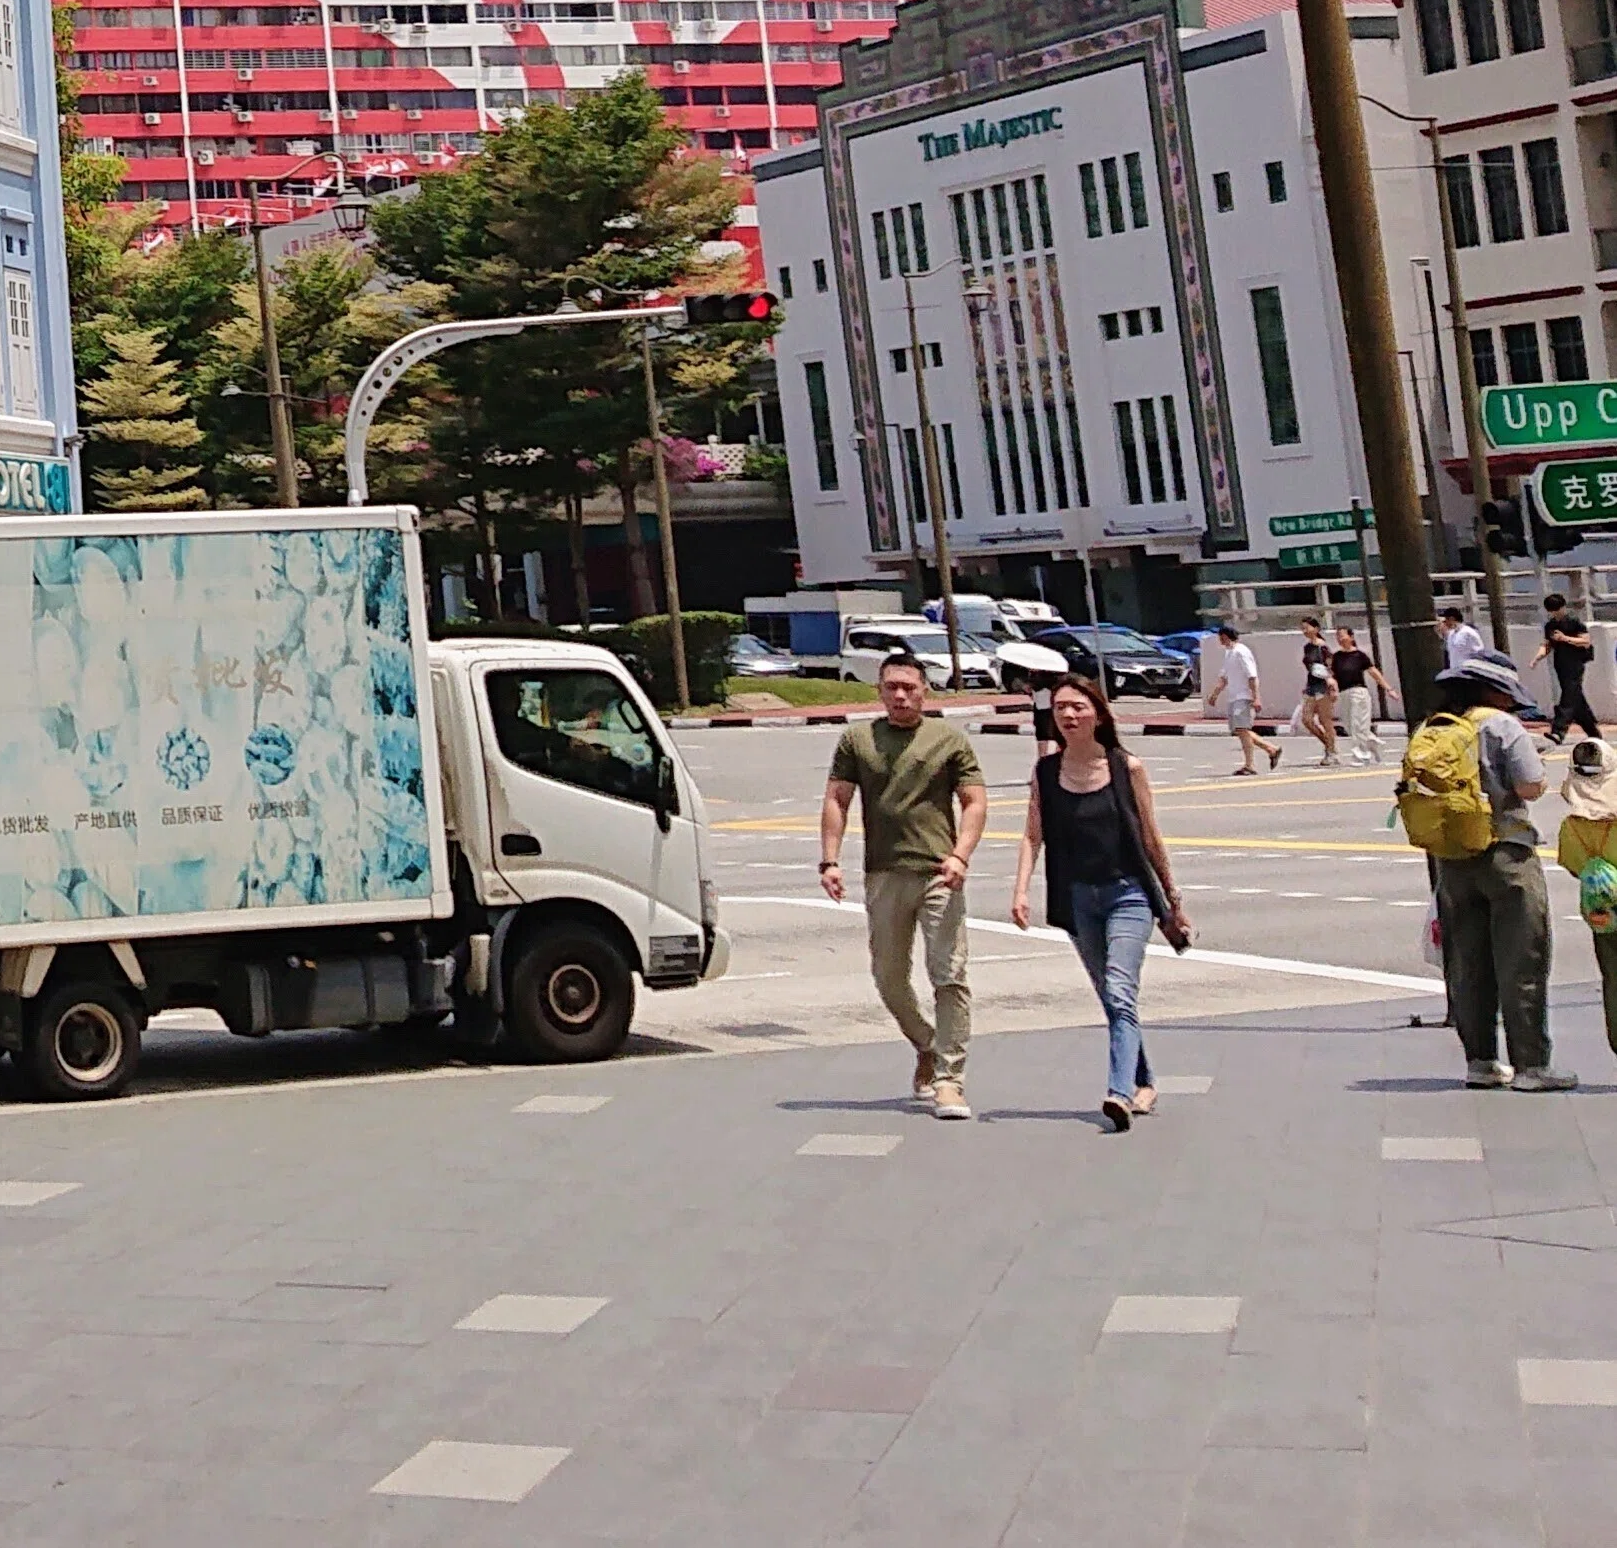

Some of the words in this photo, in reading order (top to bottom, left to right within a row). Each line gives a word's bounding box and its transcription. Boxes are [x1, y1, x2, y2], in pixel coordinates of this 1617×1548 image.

[1502, 393, 1577, 438] Upp
[1299, 517, 1335, 531] Bridge
[74, 810, 138, 830] 产地直供
[161, 805, 223, 825] 品质保证
